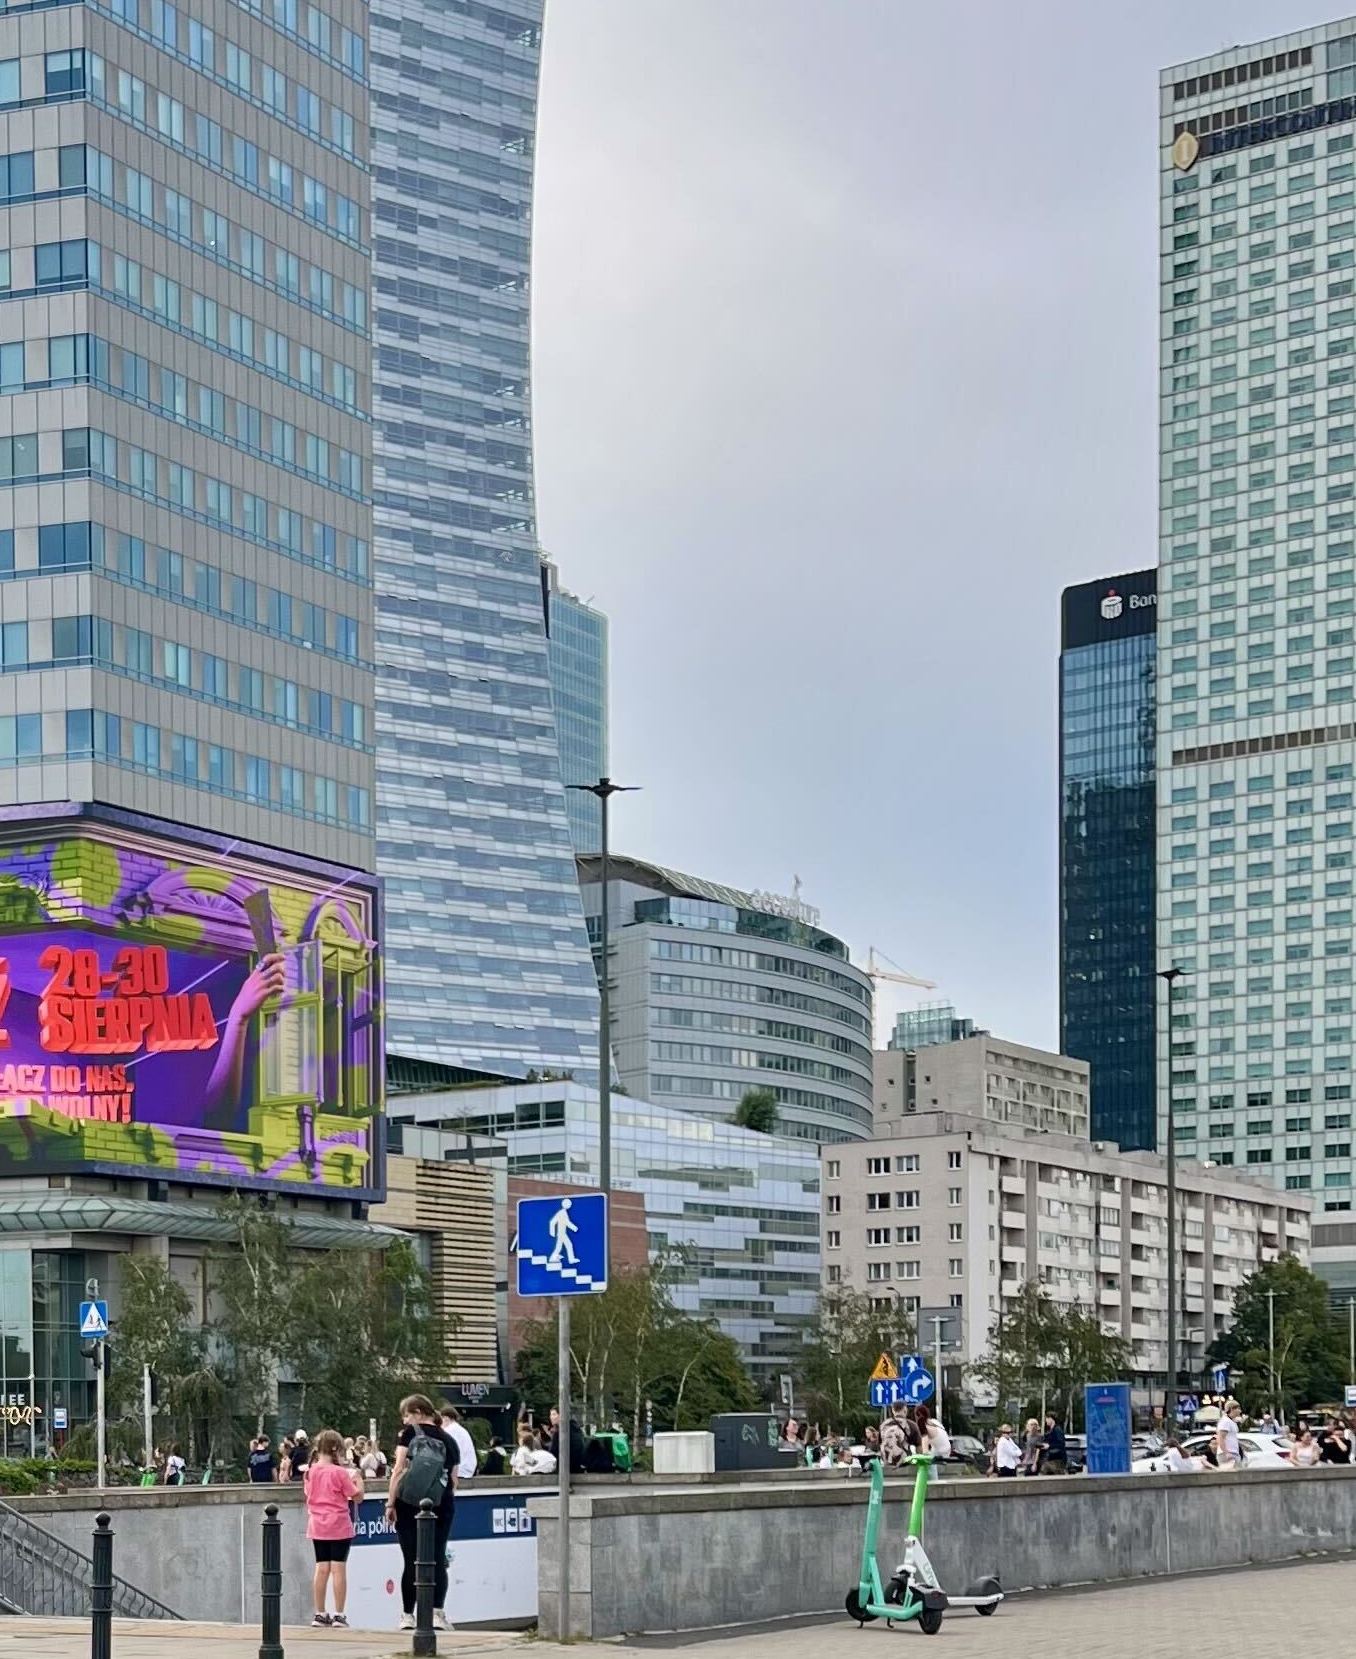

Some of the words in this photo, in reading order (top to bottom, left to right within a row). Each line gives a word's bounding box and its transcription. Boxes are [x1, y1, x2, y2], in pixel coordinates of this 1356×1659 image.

[39, 945, 168, 997] 28-30
[39, 993, 219, 1055] SIERPNIA
[50, 1065, 82, 1093] DO
[461, 1383, 490, 1396] LUMEN
